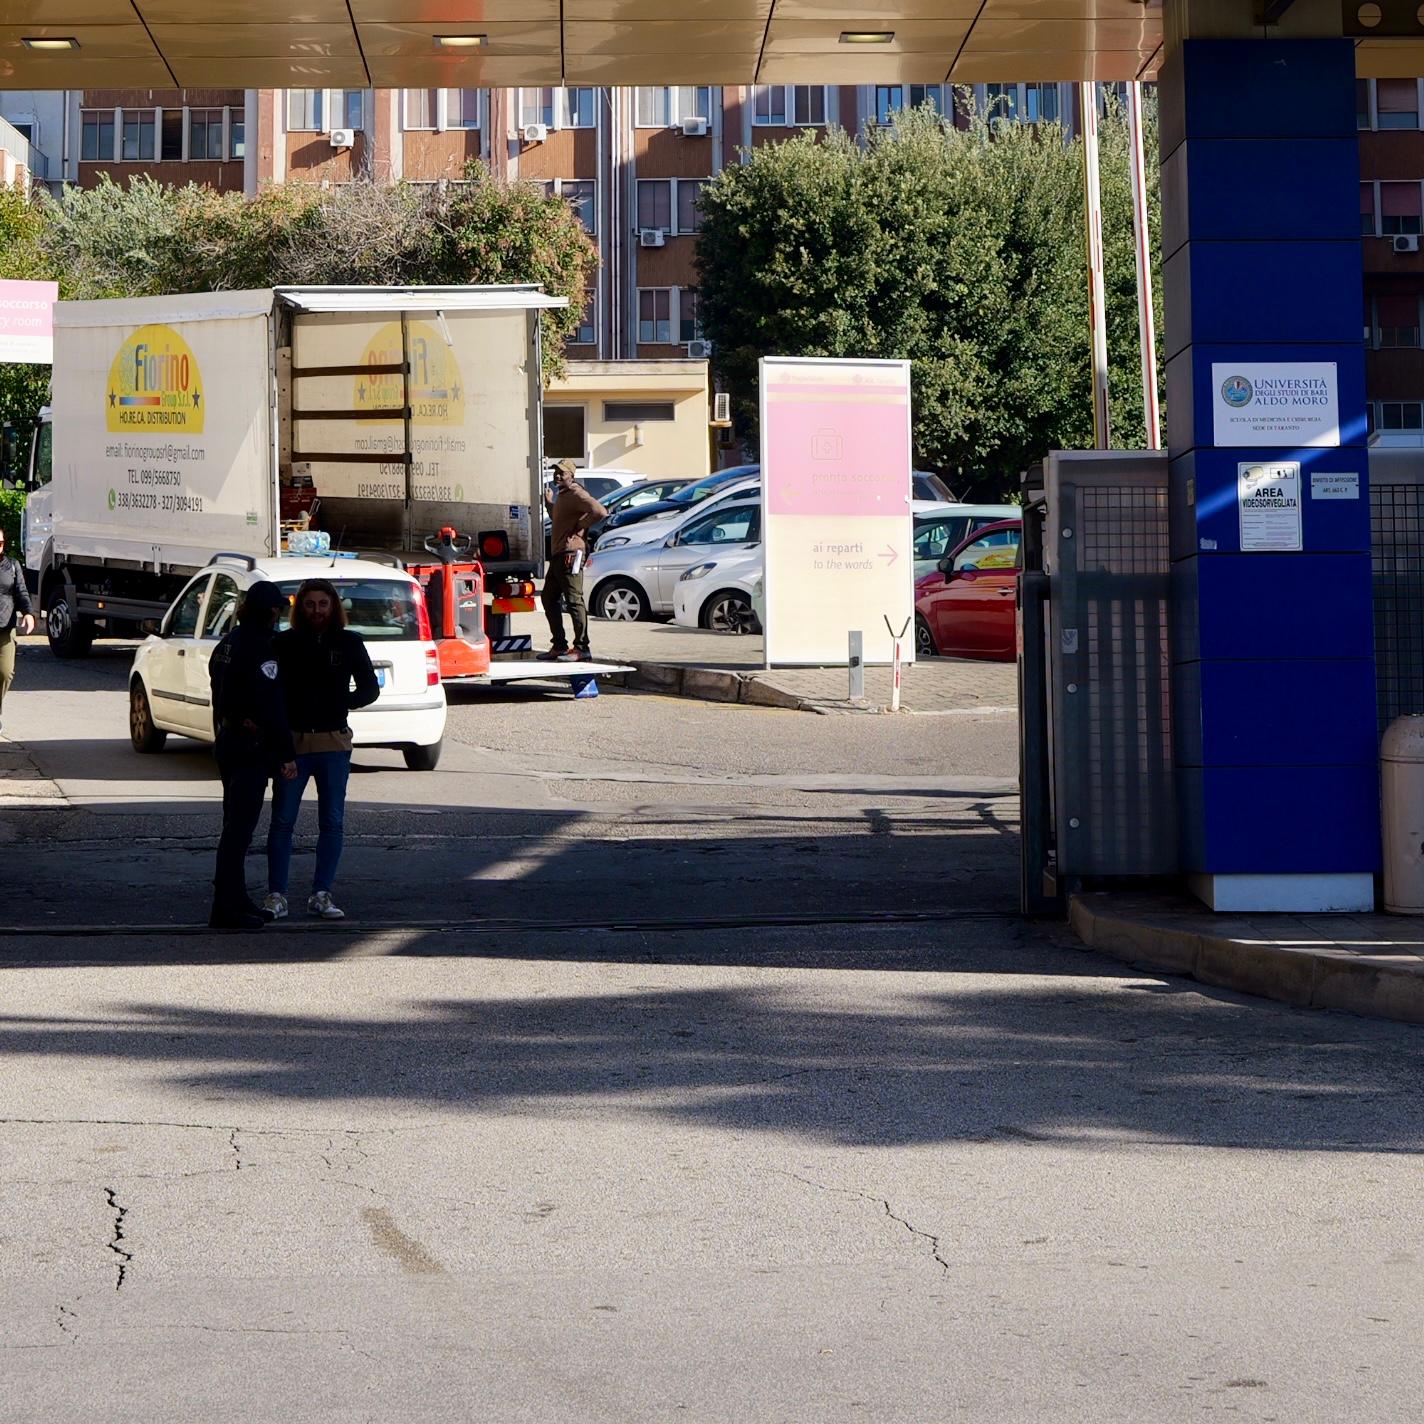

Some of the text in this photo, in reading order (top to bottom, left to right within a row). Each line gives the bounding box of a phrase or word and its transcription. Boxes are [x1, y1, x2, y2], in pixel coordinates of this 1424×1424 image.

[16, 318, 42, 327] room
[1254, 377, 1328, 389] UNIVERSITÀ
[1255, 397, 1329, 406] ALDO MORO
[147, 411, 187, 425] DISTRIBUTION
[140, 469, 181, 487] 099/5668750
[1255, 488, 1284, 498] AREA
[117, 492, 157, 510] 338/3632278
[1242, 498, 1297, 508] VIDEOSORVEGLIATA
[813, 541, 863, 556] ai reparti
[814, 560, 824, 570] to
[826, 559, 843, 569] the
